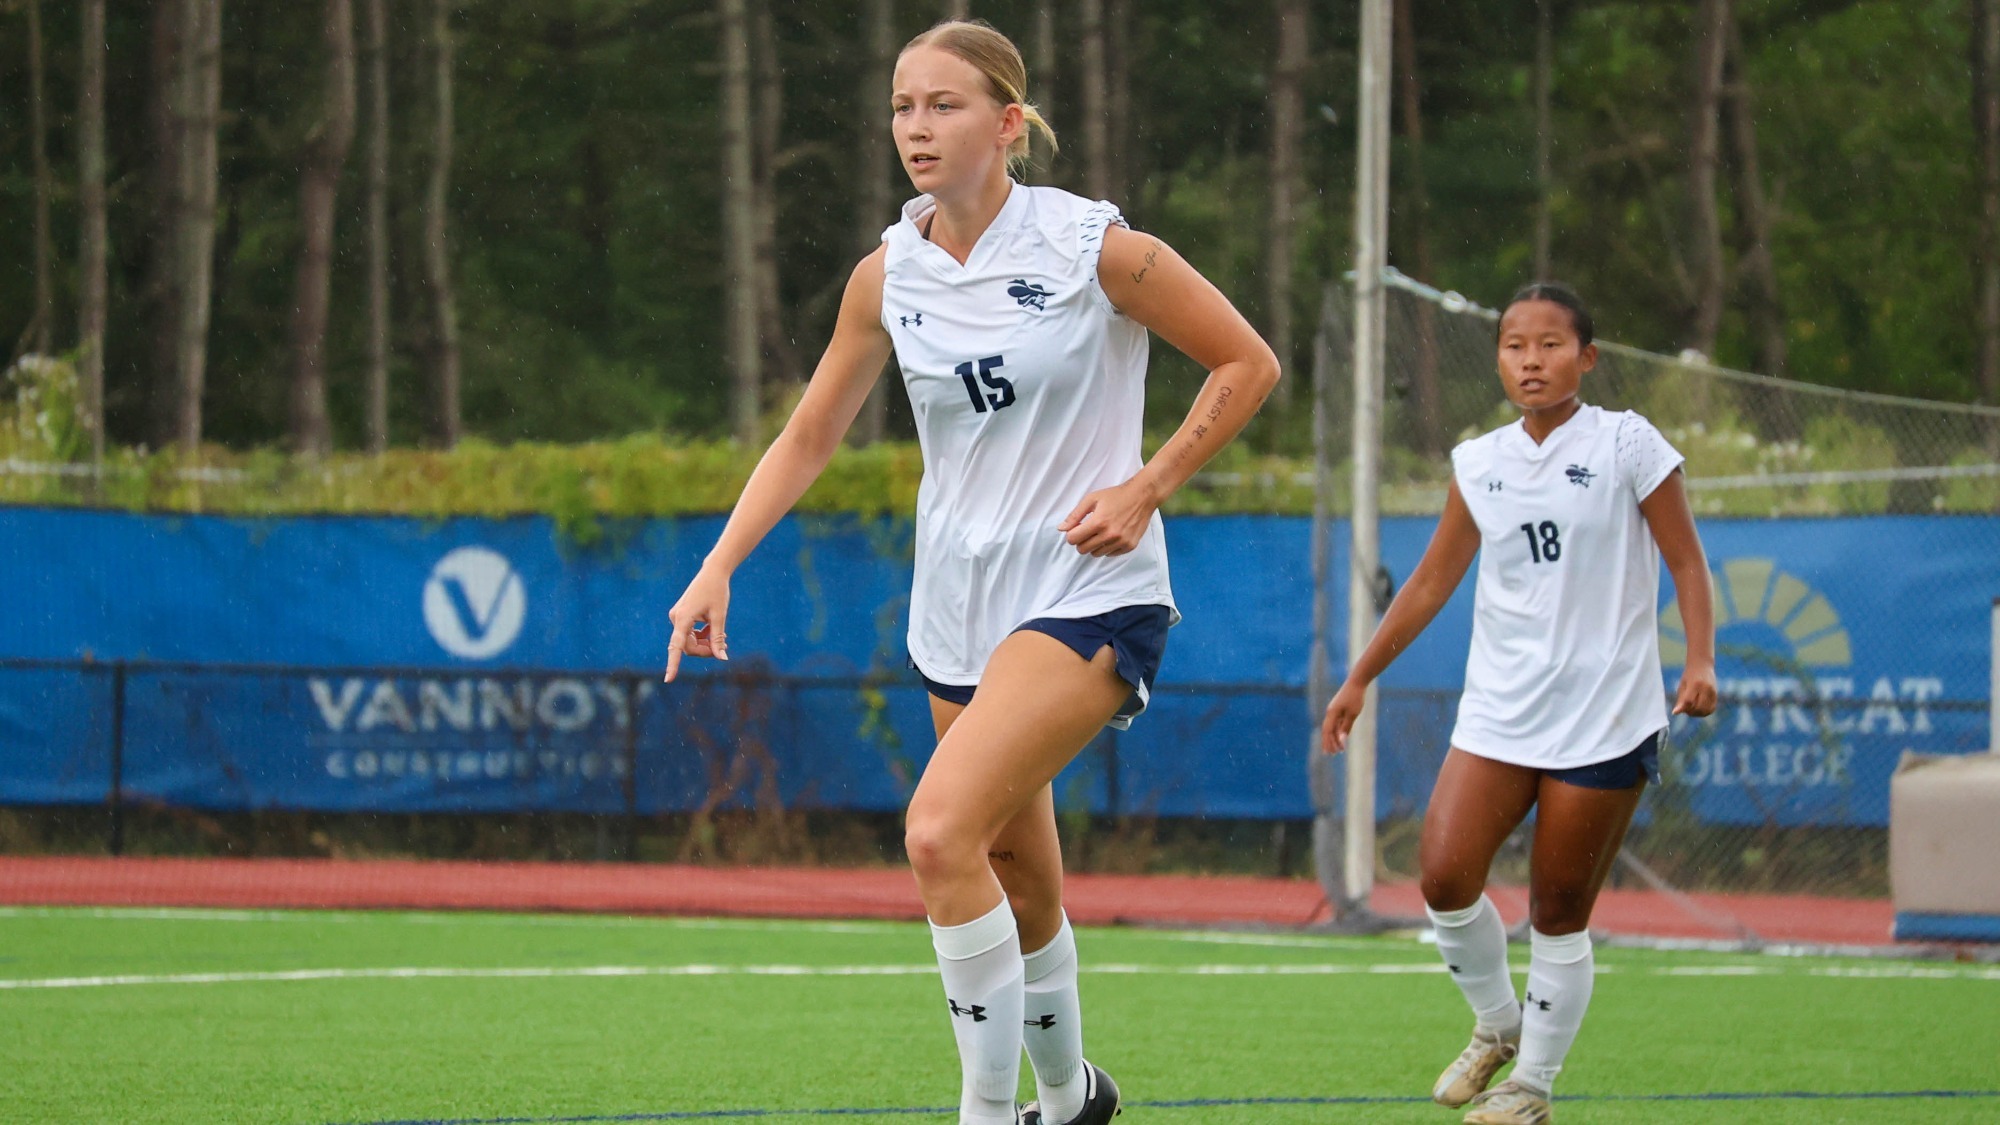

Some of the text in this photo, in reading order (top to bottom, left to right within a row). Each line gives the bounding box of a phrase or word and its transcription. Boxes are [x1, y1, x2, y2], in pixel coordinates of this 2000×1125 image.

[954, 354, 1017, 414] 15
[1192, 385, 1233, 440] CHRIST BE
[1520, 519, 1562, 564] 18
[307, 677, 654, 732] VANNOY
[1672, 742, 1855, 787] OLLEGE
